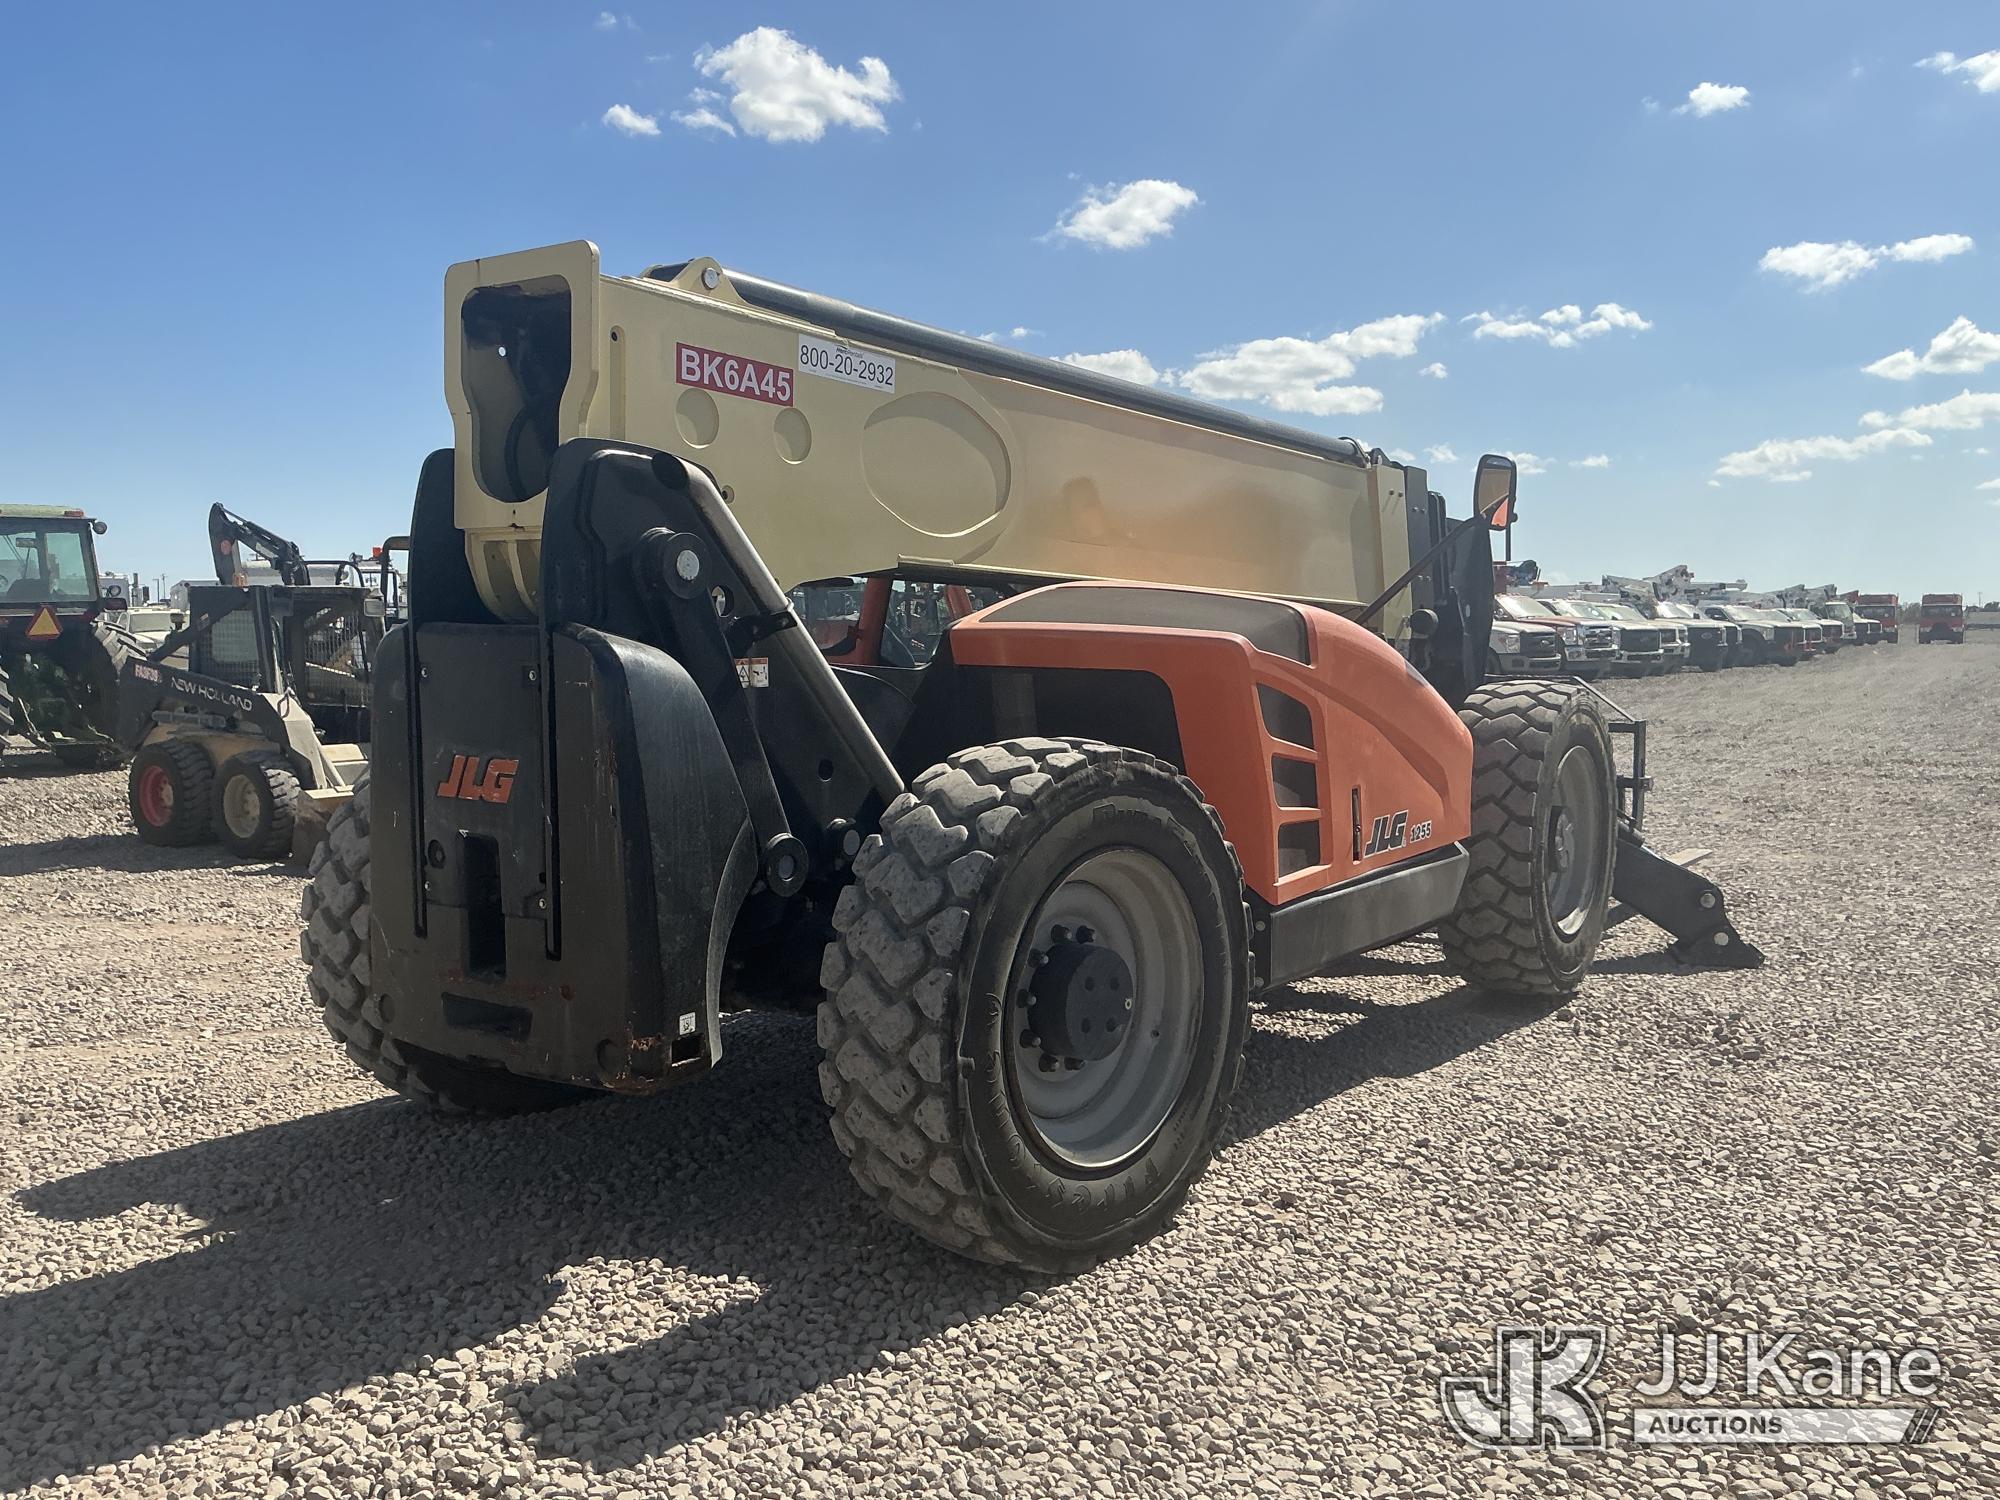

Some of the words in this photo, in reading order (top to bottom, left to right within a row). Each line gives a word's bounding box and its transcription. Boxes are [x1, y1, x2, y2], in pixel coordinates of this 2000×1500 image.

[680, 347, 790, 402] BK6A45
[800, 344, 893, 386] 800-20-2932
[199, 684, 253, 712] HOLLAND
[437, 755, 519, 803] JLG
[1363, 810, 1408, 858] JLG
[1410, 820, 1431, 844] 1255
